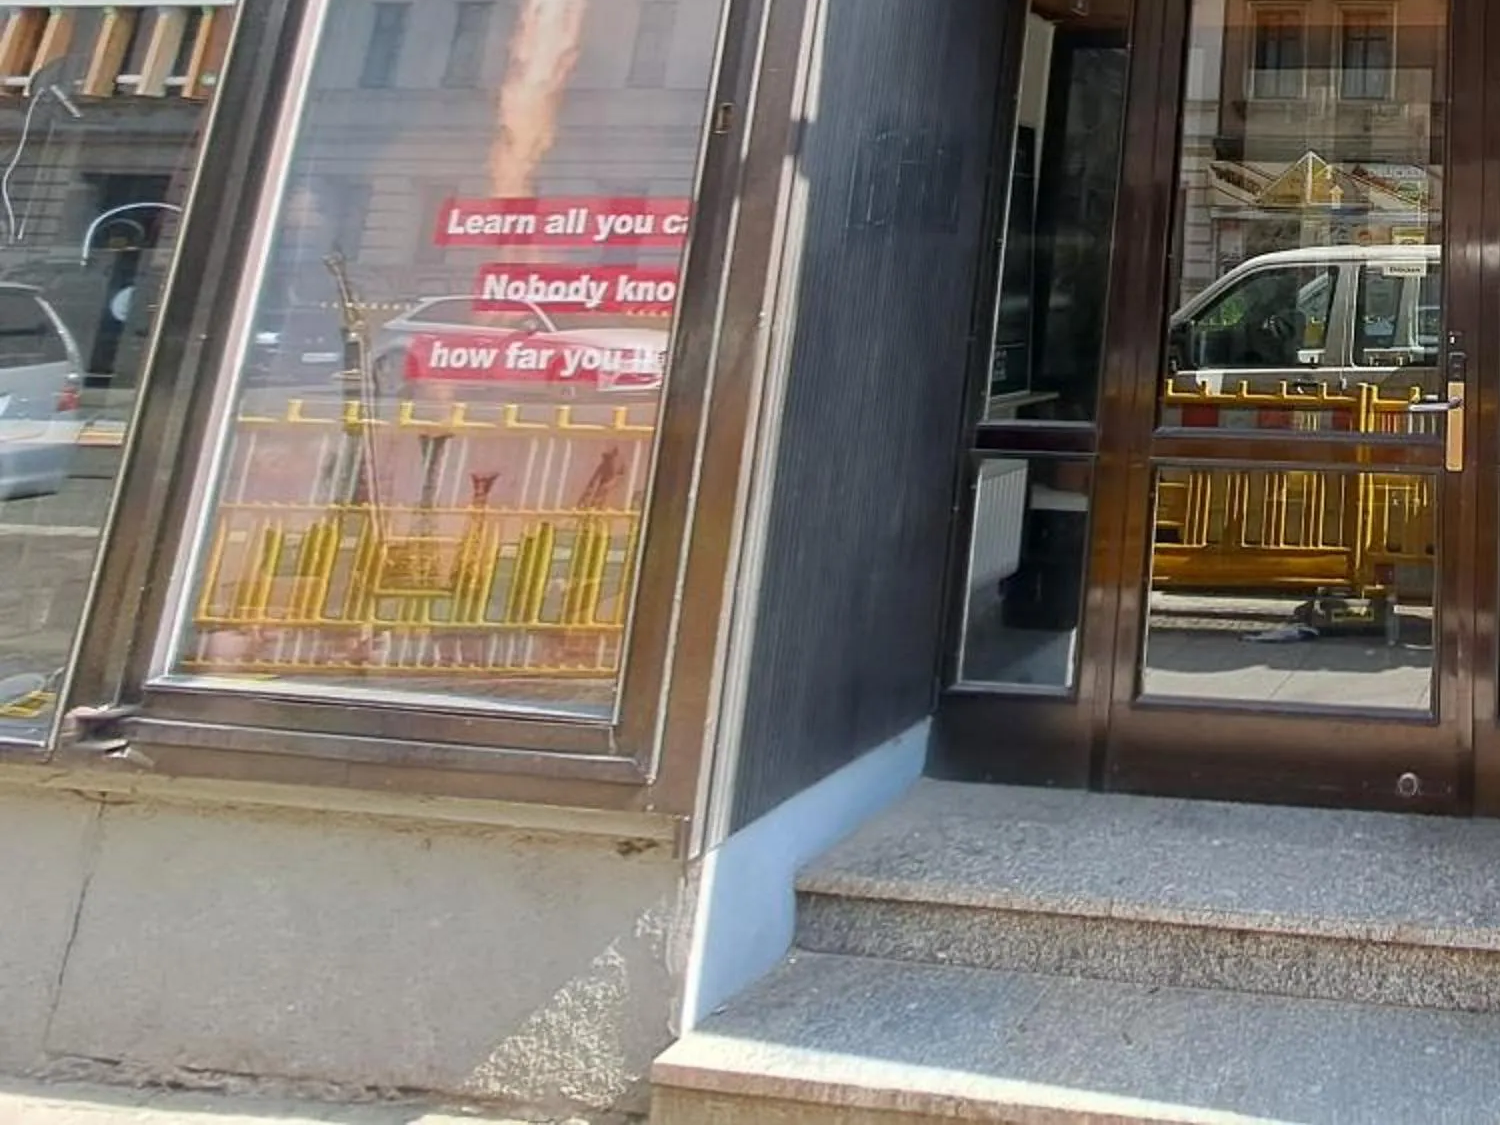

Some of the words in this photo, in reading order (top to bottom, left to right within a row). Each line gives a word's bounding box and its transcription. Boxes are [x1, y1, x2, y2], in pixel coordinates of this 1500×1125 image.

[448, 209, 535, 234] Learn
[544, 208, 588, 234] all
[592, 214, 654, 241] you
[482, 275, 608, 307] Nobody
[429, 342, 498, 369] how
[504, 342, 556, 369] far
[559, 347, 625, 377] you
